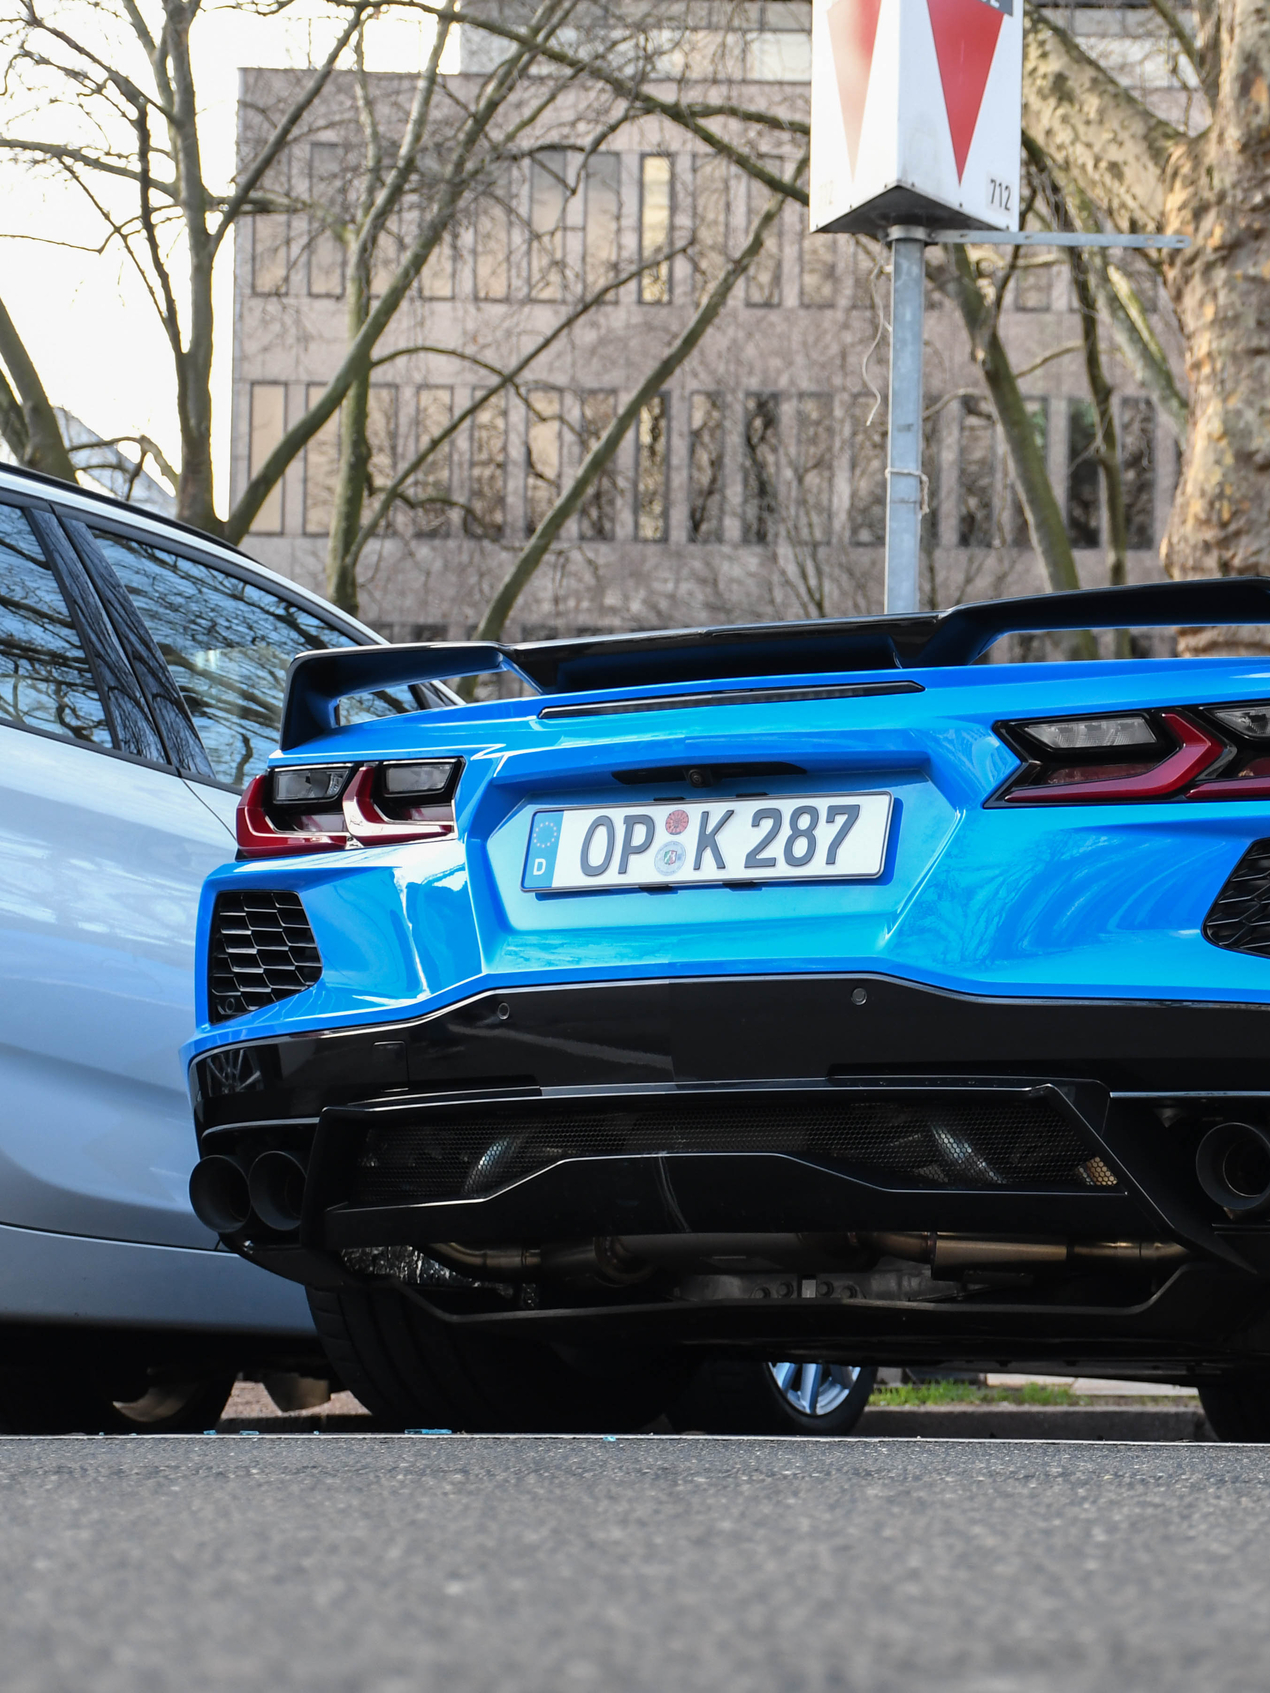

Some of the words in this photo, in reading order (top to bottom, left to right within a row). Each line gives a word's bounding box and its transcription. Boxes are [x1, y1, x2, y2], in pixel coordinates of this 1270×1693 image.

[990, 179, 1011, 211] 712
[580, 814, 655, 876] OP
[693, 809, 735, 871] K
[743, 804, 861, 869] 287
[533, 858, 547, 876] D
